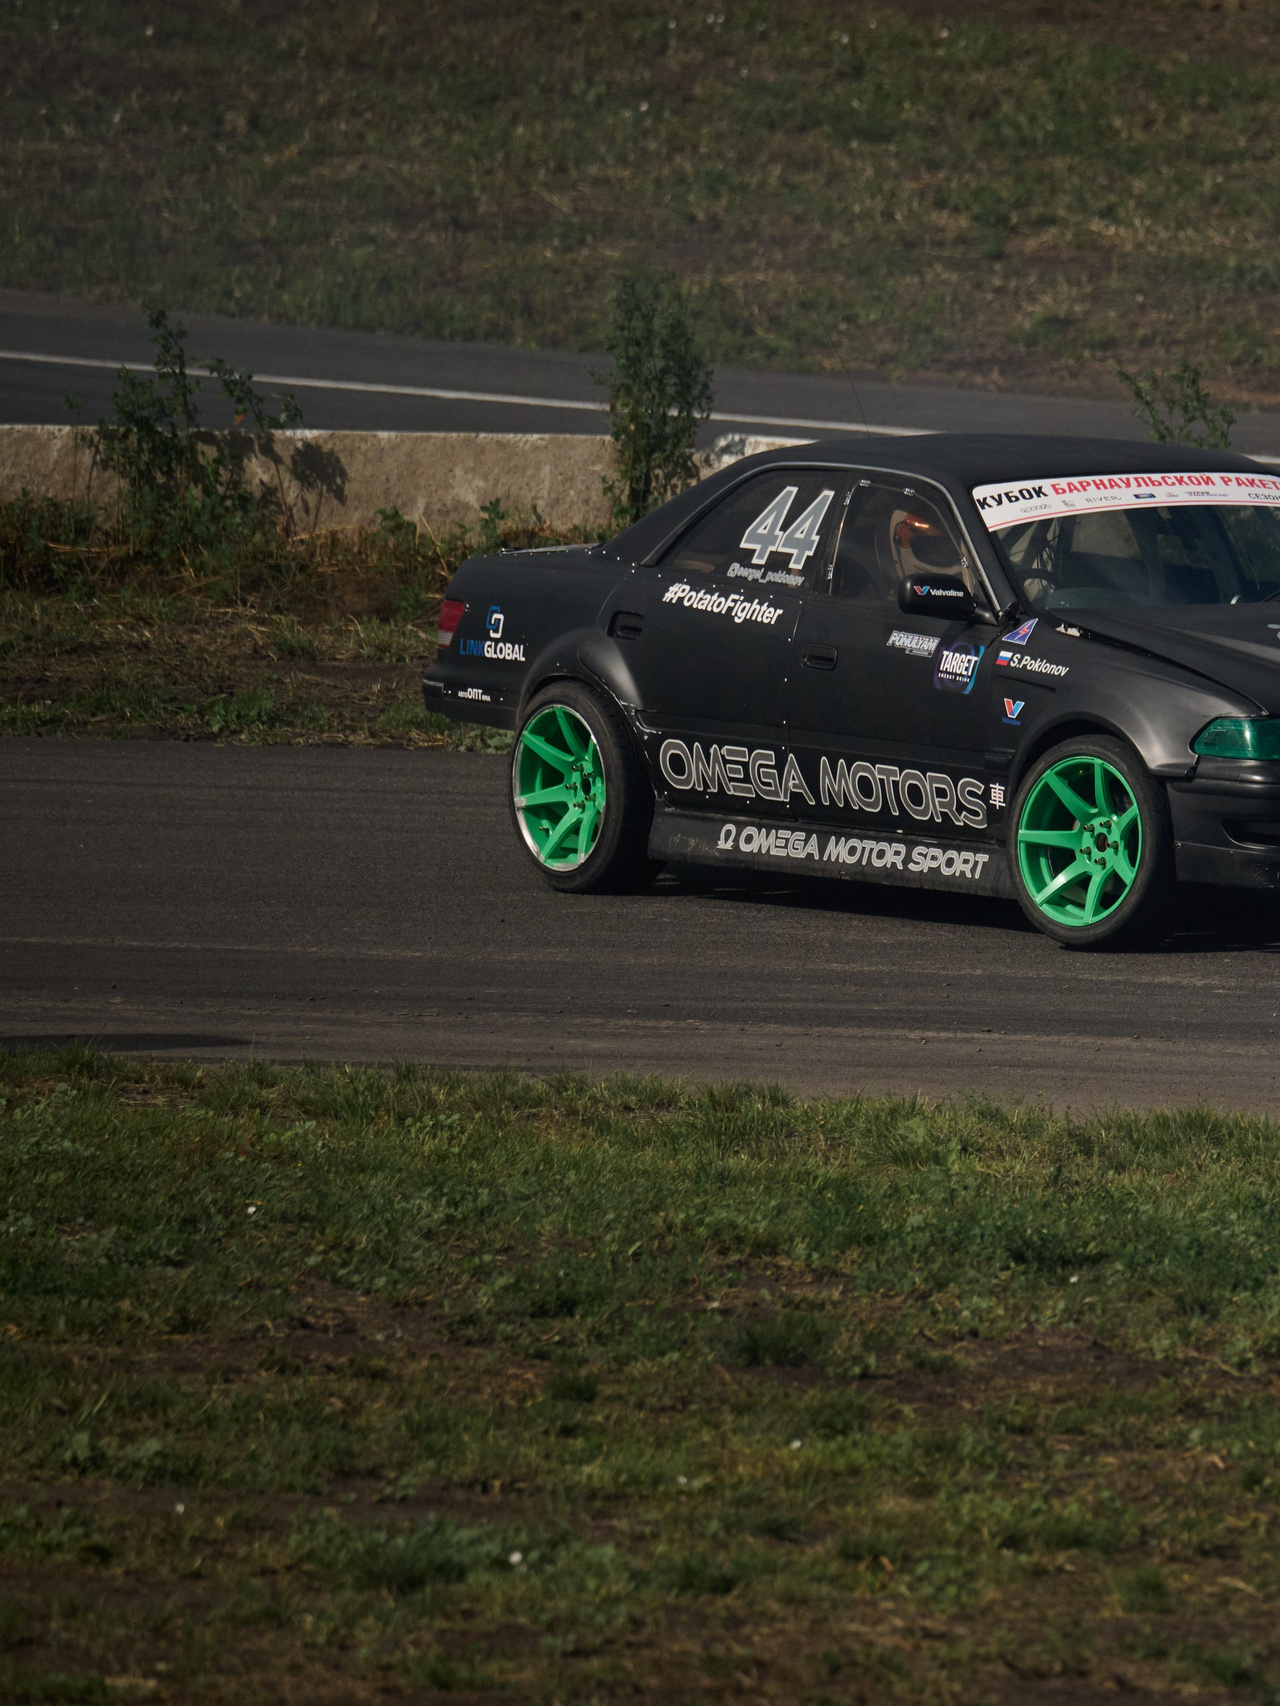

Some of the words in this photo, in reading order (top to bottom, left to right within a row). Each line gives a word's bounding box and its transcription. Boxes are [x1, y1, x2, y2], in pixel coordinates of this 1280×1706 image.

[976, 486, 1049, 511] КУБОК
[1051, 473, 1216, 496] БАРНАУЛЬСКОЙ
[740, 486, 835, 570] 44
[662, 582, 783, 625] #PotatoFighter
[930, 588, 964, 597] Valvoline
[460, 639, 526, 661] LINKGLOBAL
[939, 650, 979, 676] TARGET
[1010, 653, 1069, 676] S.Poklonov
[659, 739, 816, 806] OMEGA
[819, 756, 988, 829] MOTORS
[739, 826, 819, 860] OMEGA
[823, 836, 906, 870] MOTOR
[908, 846, 989, 879] SPORT
